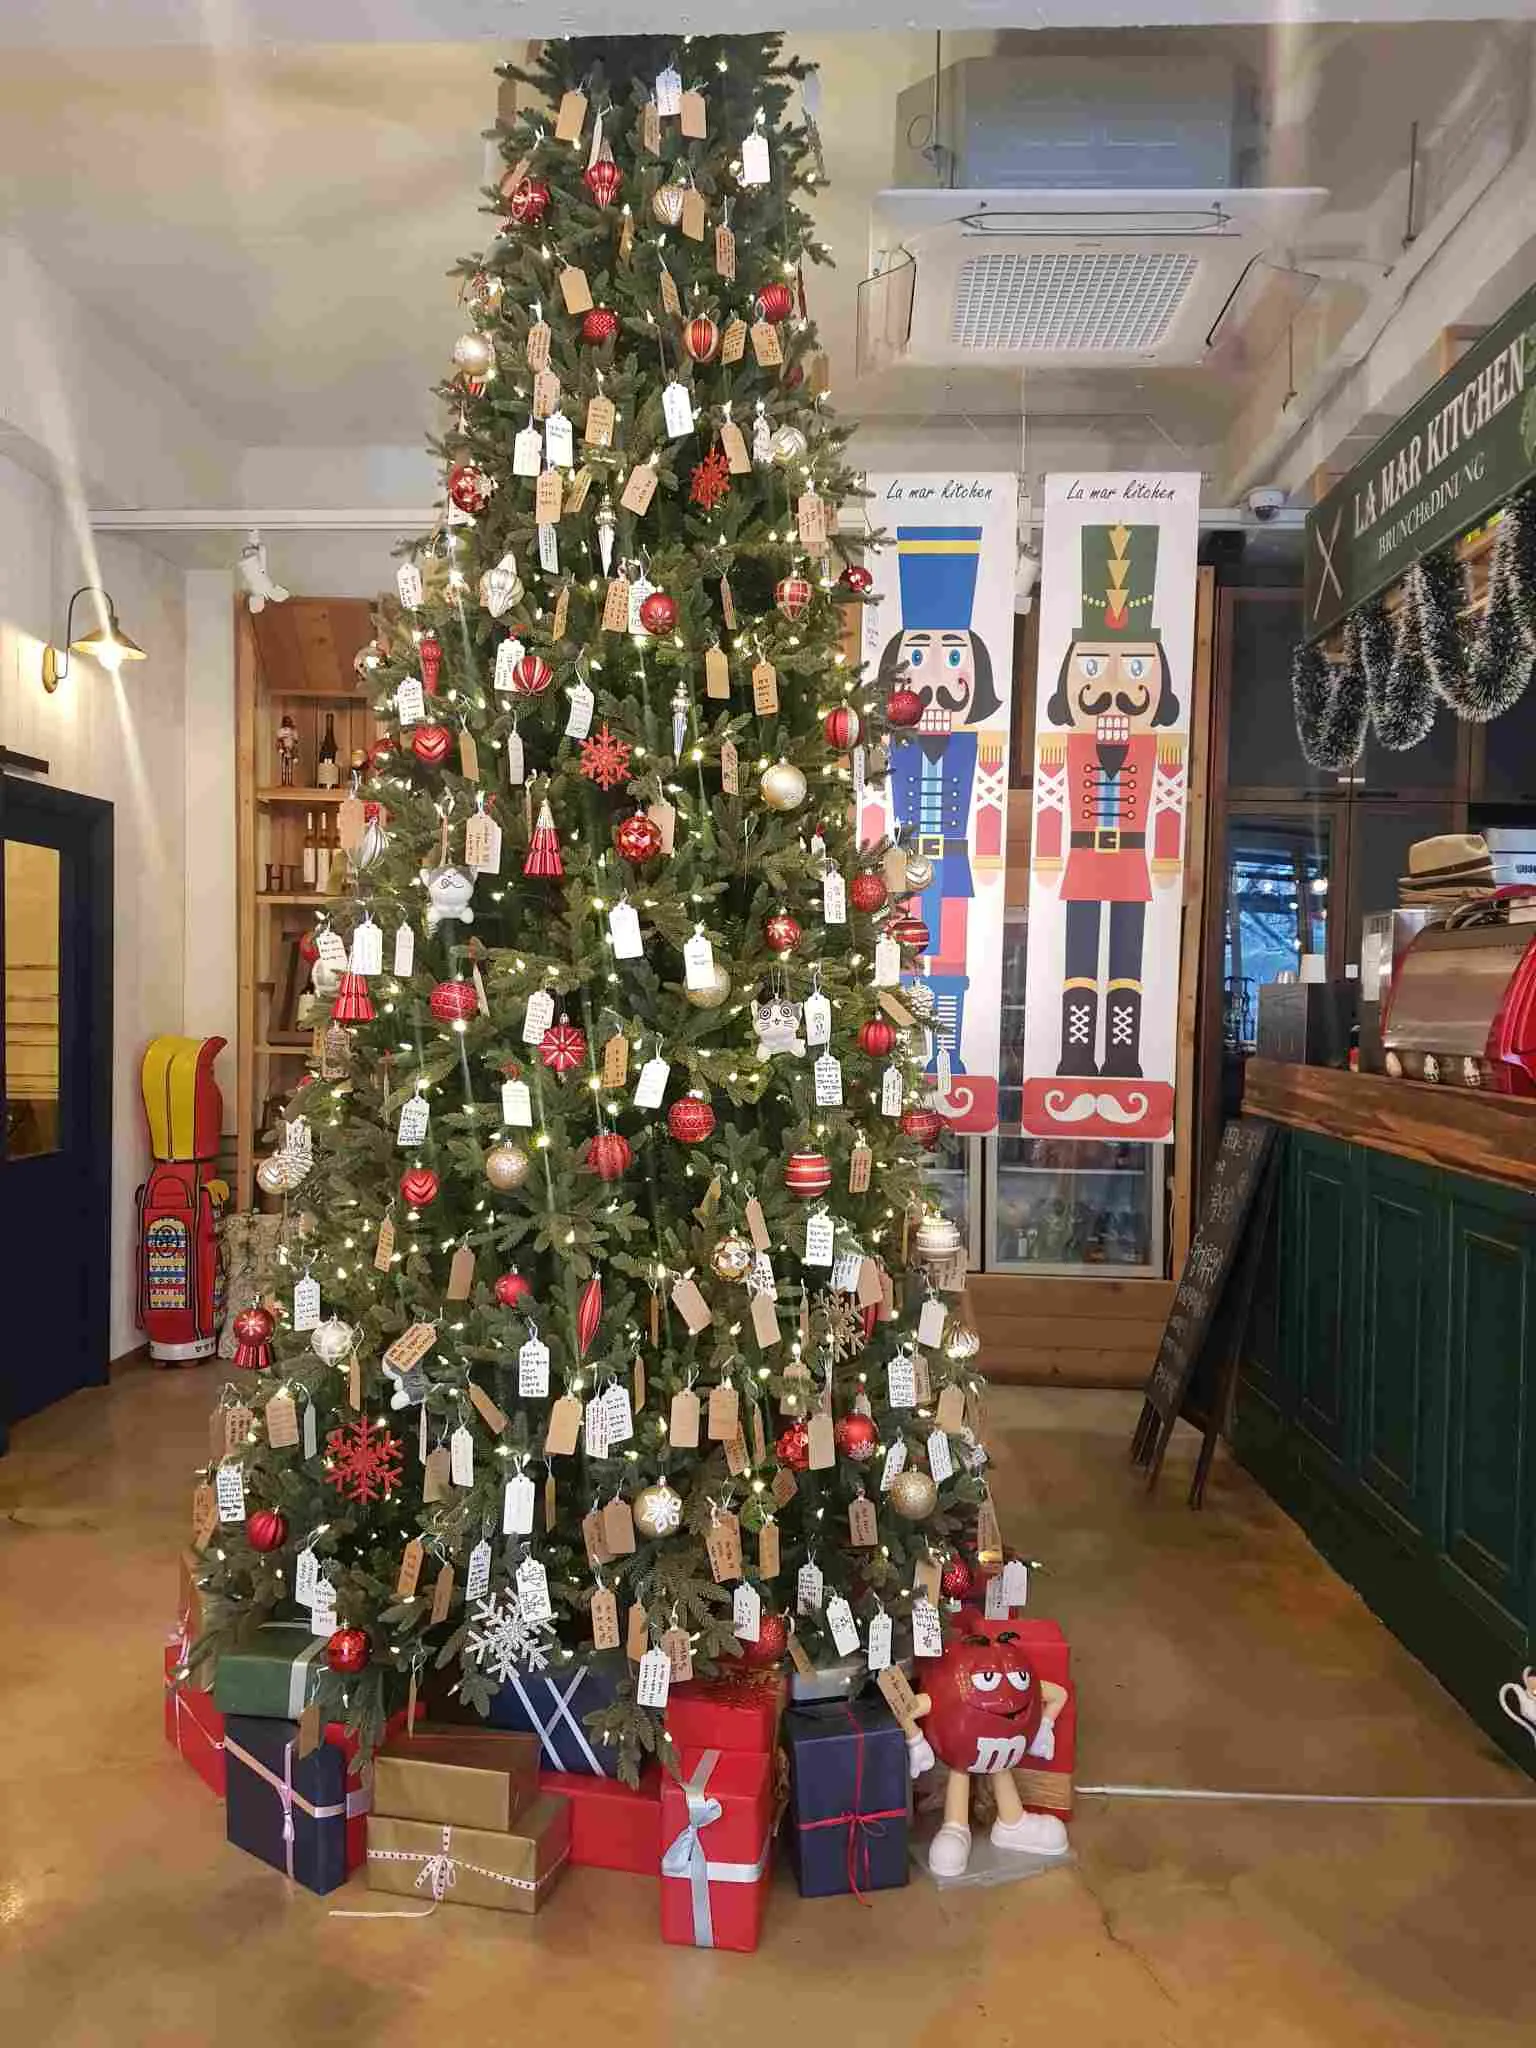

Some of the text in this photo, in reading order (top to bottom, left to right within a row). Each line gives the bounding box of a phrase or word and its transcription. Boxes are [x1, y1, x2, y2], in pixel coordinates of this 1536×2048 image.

[1354, 331, 1526, 539] LA MAR KITCHEN
[886, 479, 993, 500] La mar kitchen
[1066, 479, 1176, 500] La mar kitchen
